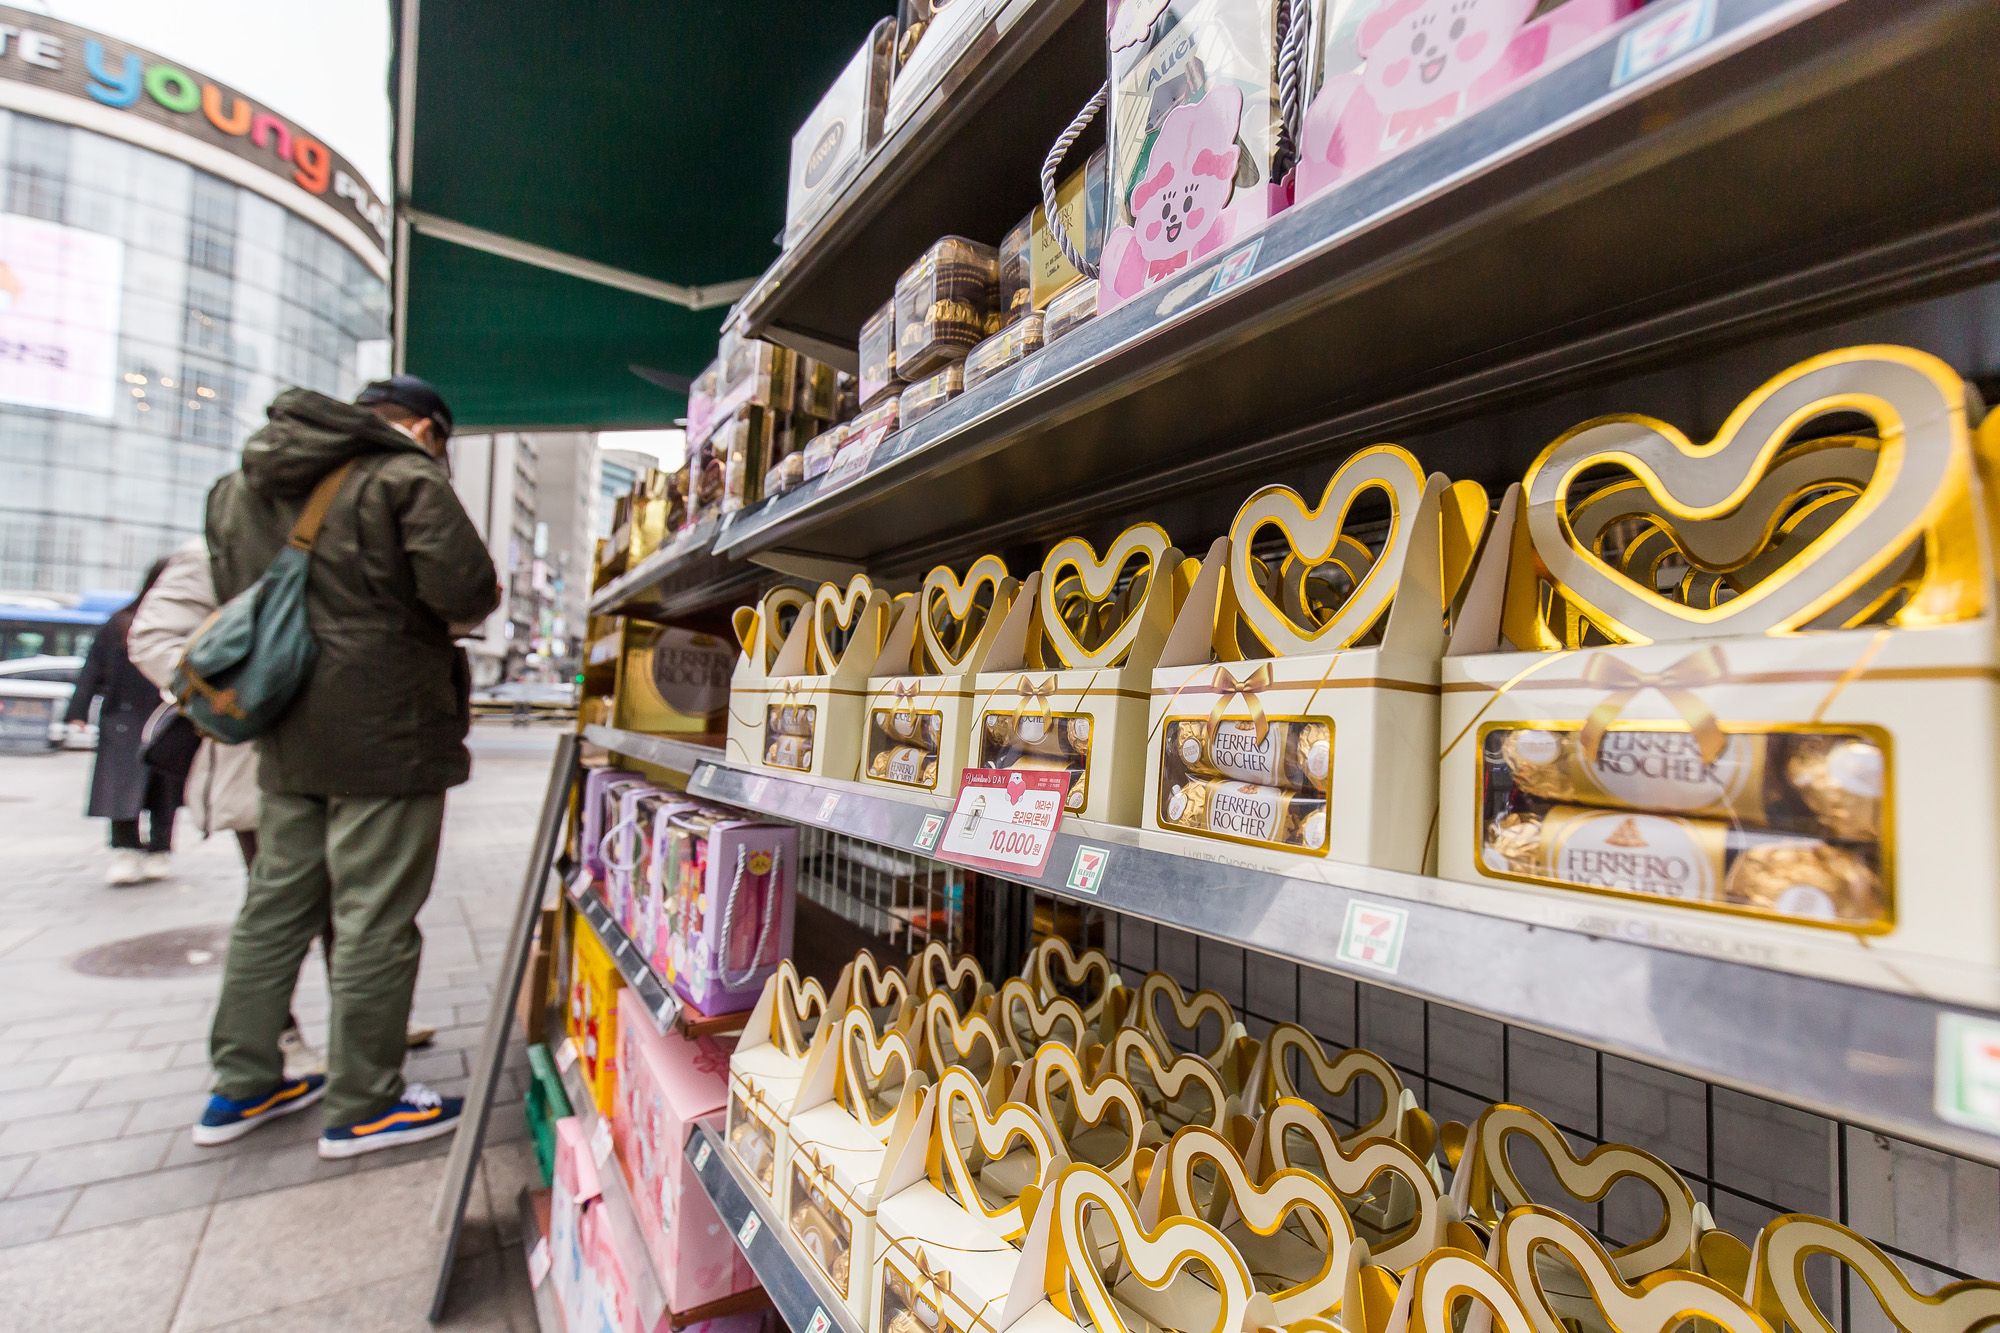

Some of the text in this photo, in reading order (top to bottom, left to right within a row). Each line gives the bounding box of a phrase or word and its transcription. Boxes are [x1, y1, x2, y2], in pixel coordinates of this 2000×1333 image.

[84, 38, 331, 195] young
[1216, 733, 1270, 754] FERRERO
[1216, 750, 1270, 773] ROCHER
[992, 775, 1006, 785] DAY
[1215, 793, 1271, 820] FERRERO
[1212, 810, 1267, 839] ROCHER
[1567, 849, 1690, 884] FERRERO
